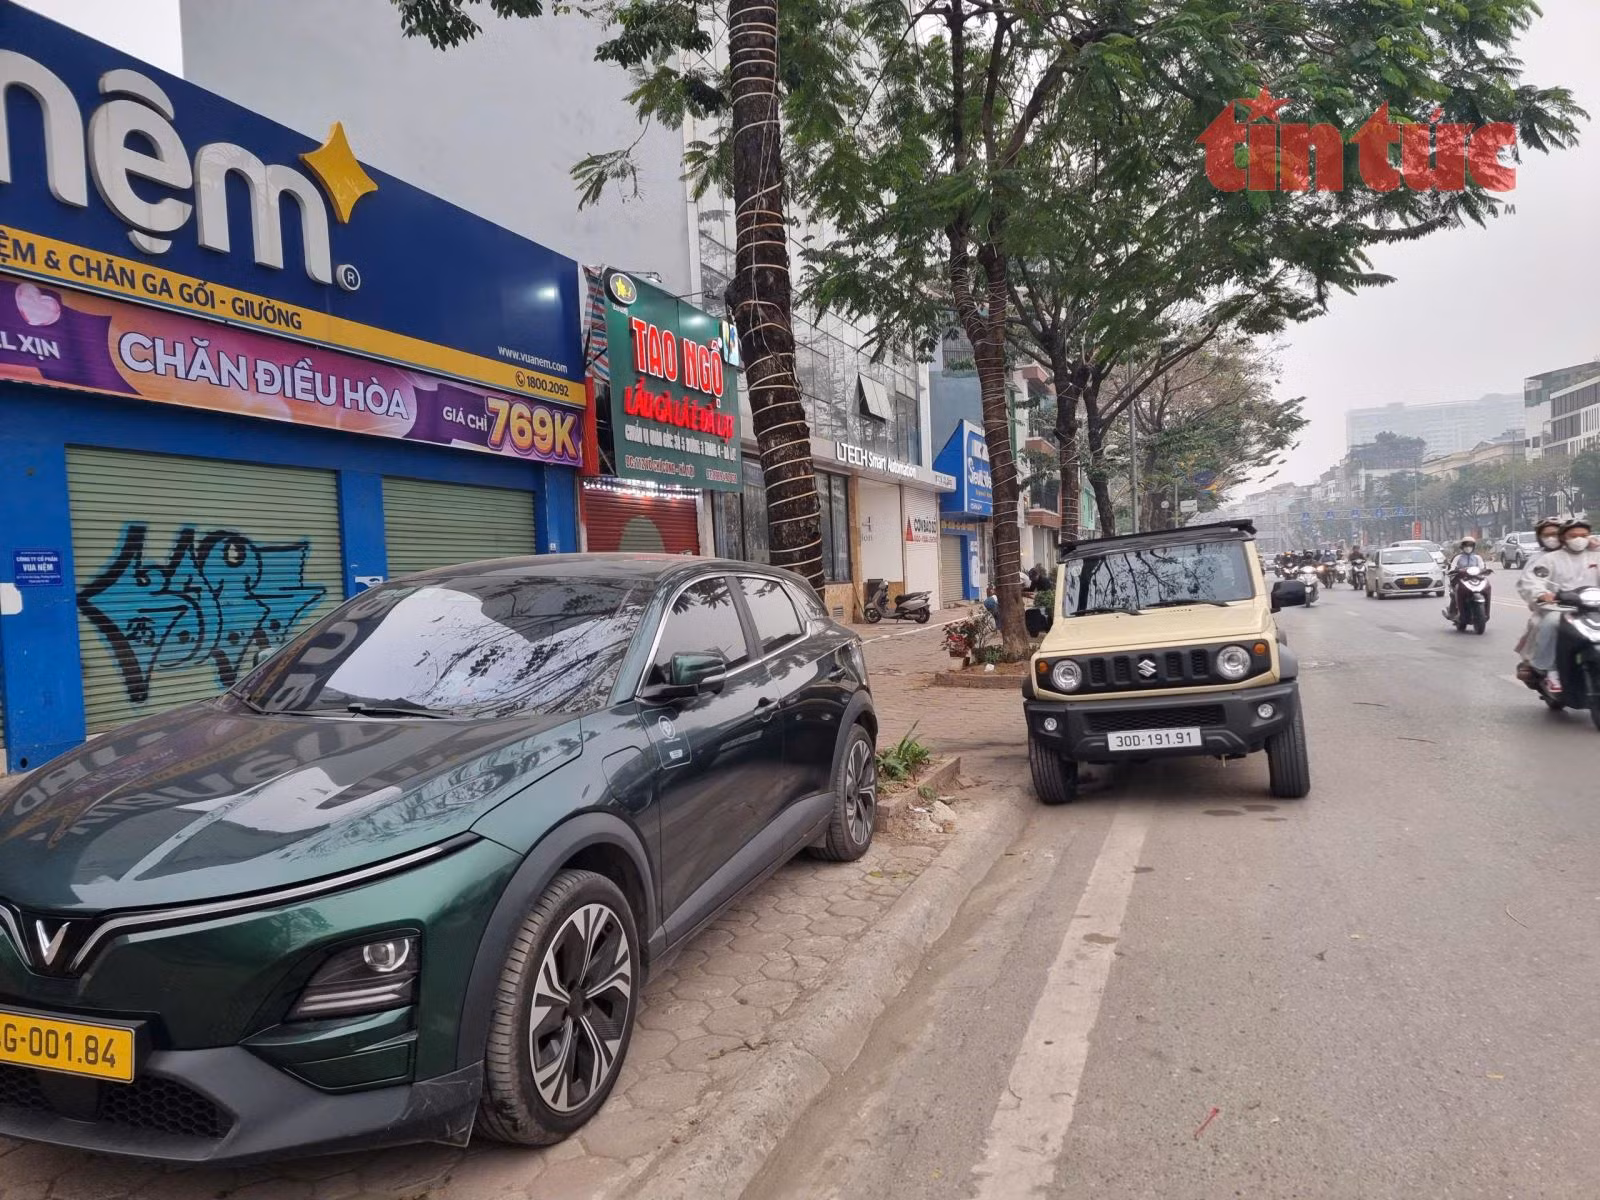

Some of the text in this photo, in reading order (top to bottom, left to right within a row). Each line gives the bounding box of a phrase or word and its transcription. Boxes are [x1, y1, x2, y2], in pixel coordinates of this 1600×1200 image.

[44, 250, 61, 271] &
[69, 254, 136, 290] CHĂN
[142, 273, 173, 298] GA
[179, 280, 216, 309] GỐI
[231, 297, 302, 330] GIƯỜNG
[498, 345, 568, 374] www.vuanem.com
[631, 316, 678, 382] TAO
[0, 331, 578, 459] L XỊN CHĂN ĐIỀU HÒA GIÁ CHỈ 769K
[527, 376, 569, 397] 1800.2092
[868, 451, 886, 471] Smart
[0, 1023, 116, 1068] G-001.84
